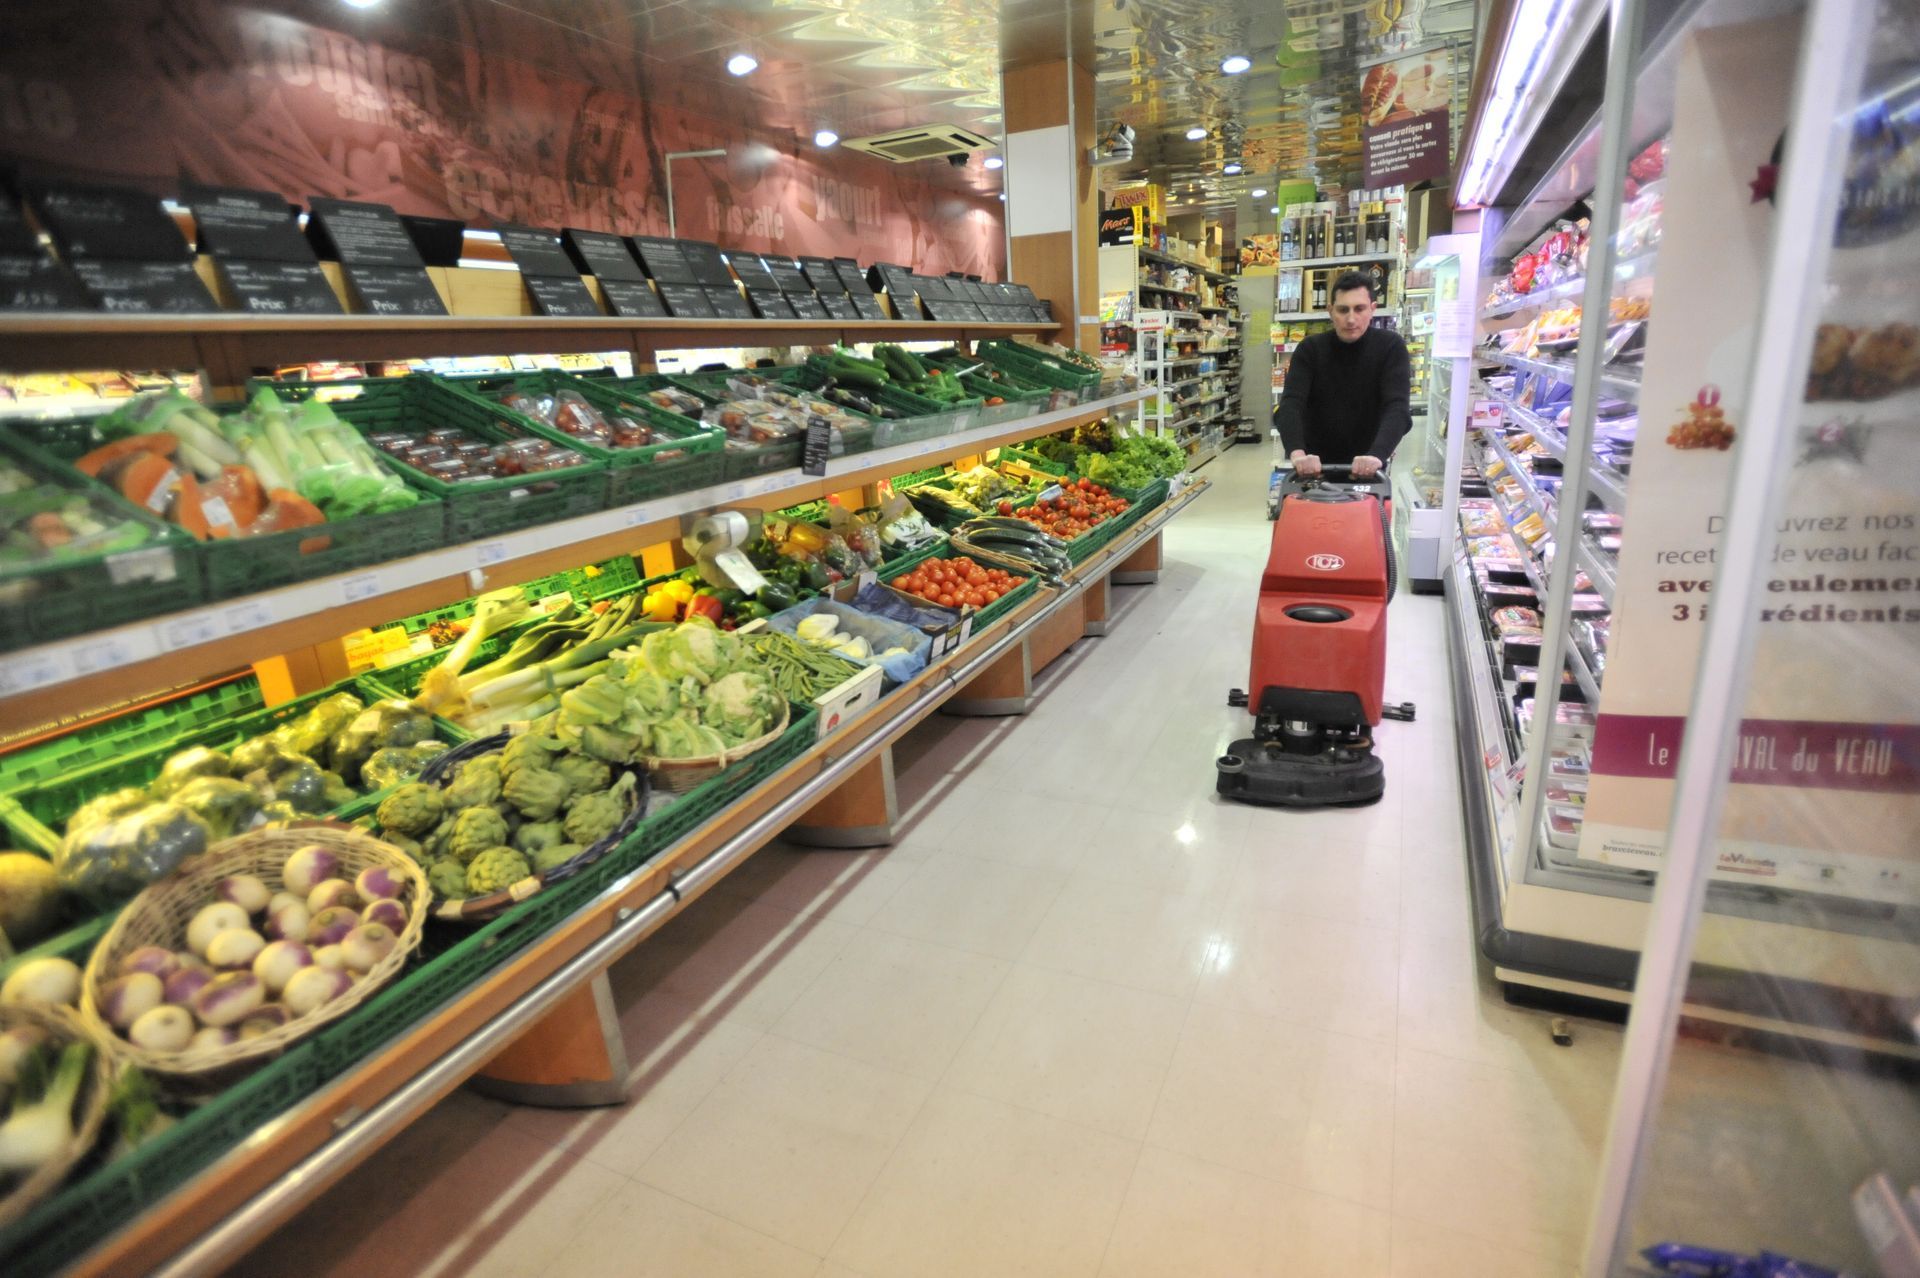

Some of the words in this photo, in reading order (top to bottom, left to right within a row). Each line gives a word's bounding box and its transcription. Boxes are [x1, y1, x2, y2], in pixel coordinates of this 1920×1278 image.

[1392, 124, 1424, 140] pratique
[1864, 514, 1915, 531] nos
[1803, 548, 1868, 563] veau
[1672, 604, 1690, 622] 3
[1650, 732, 1668, 766] le
[1791, 738, 1819, 772] du
[1835, 739, 1893, 776] VEAU
